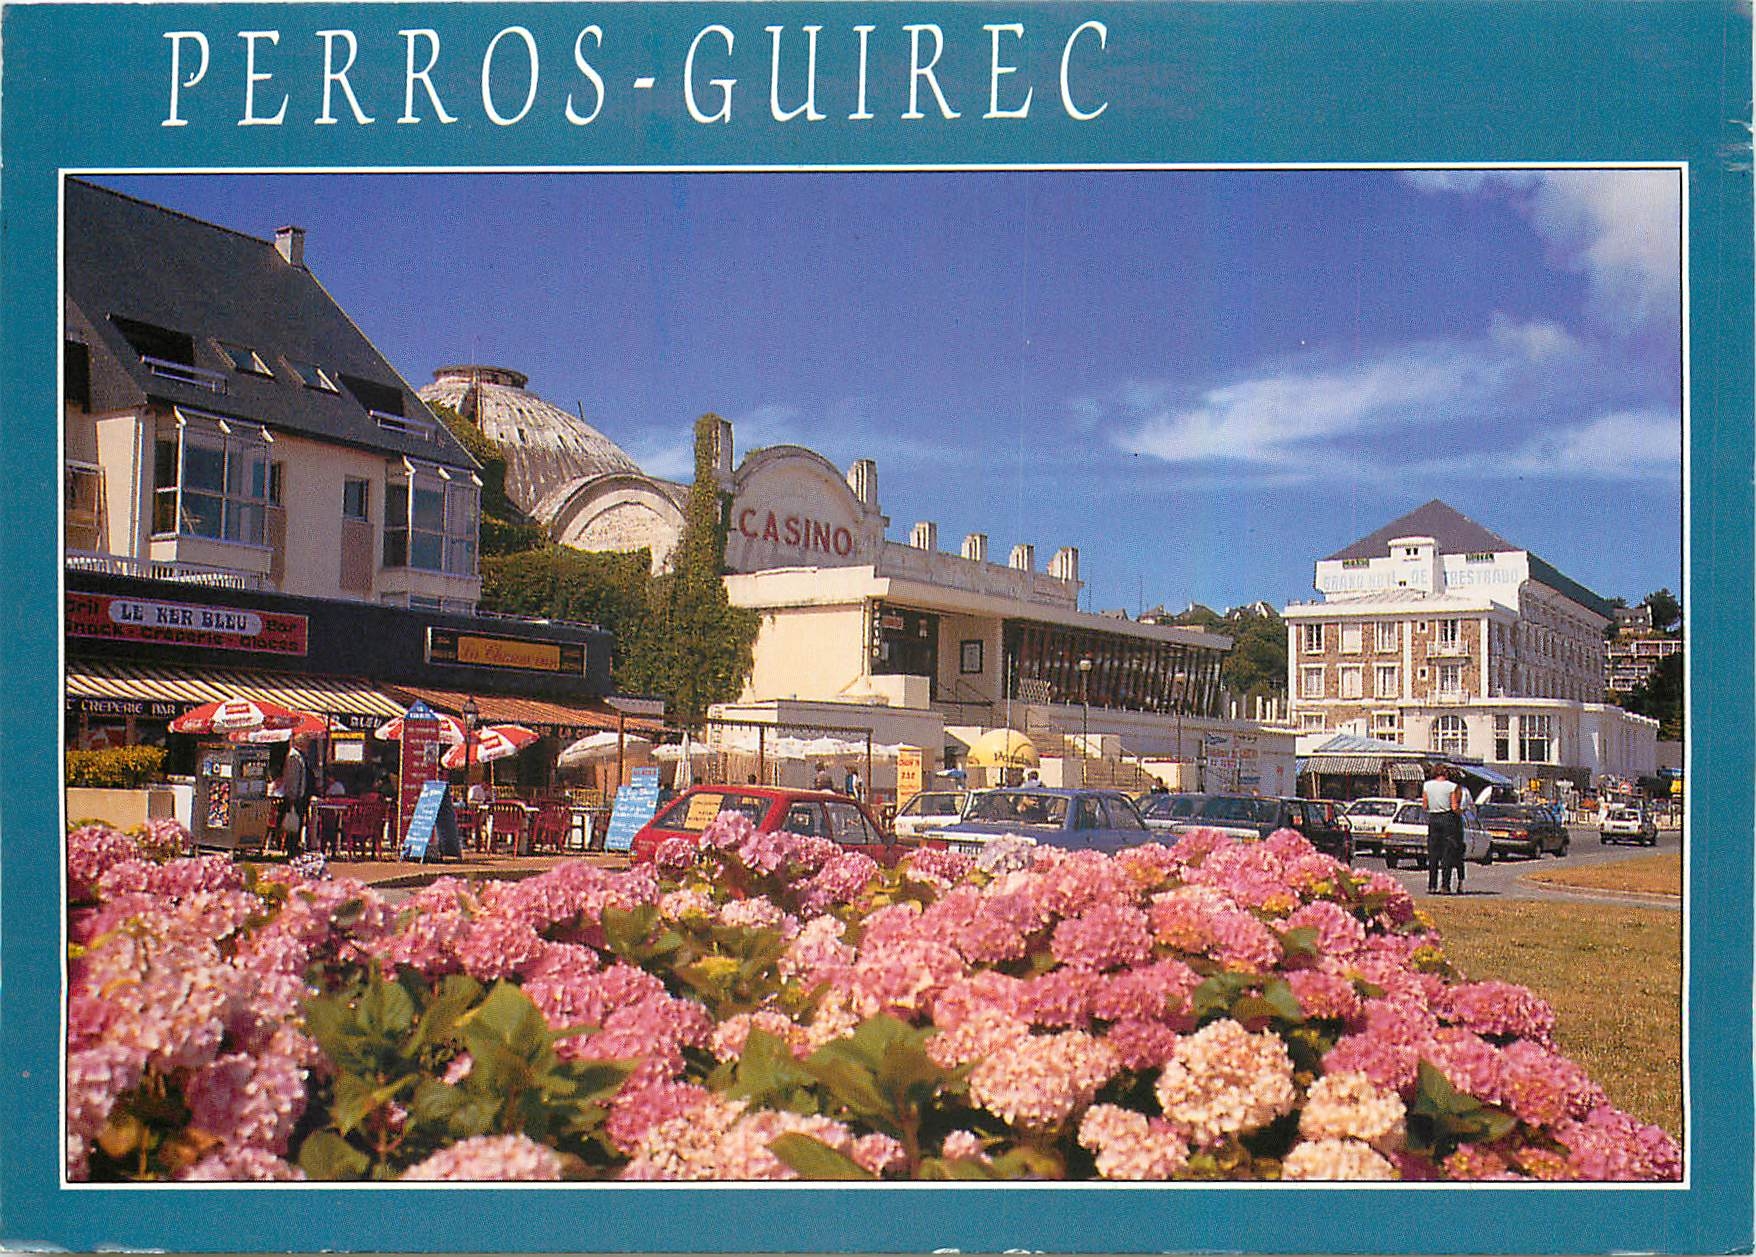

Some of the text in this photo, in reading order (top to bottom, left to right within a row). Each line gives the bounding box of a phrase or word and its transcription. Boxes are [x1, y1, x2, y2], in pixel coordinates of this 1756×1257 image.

[739, 509, 854, 558] CASINO
[1323, 574, 1364, 590] GRAND
[1411, 568, 1428, 584] DE
[121, 603, 144, 621] LE
[156, 606, 193, 627] KER
[201, 612, 248, 632] BLEU
[151, 703, 176, 715] BAR
